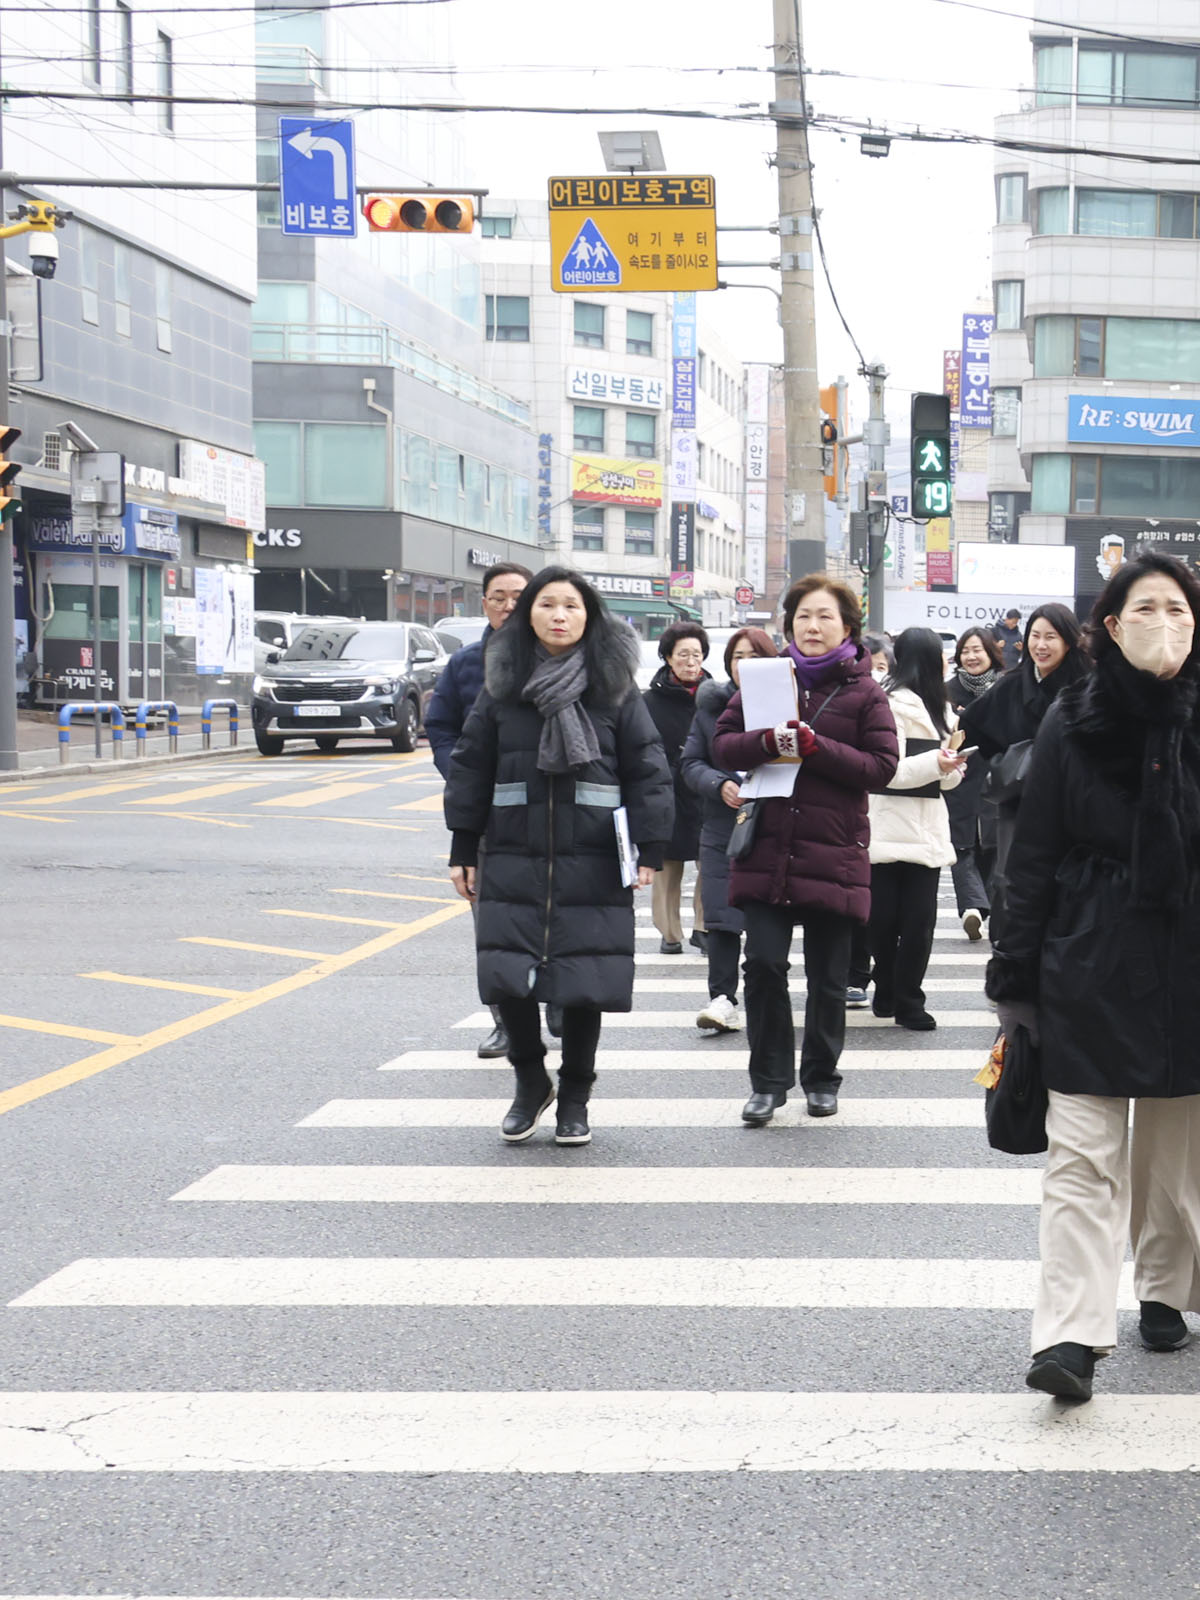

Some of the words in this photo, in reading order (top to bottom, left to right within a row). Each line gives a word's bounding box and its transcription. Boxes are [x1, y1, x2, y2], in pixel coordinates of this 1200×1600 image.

[552, 178, 710, 205] 어린이보호구역
[286, 202, 352, 231] 비보호
[629, 254, 662, 270] 속도를
[665, 253, 709, 270] 줄이시오
[564, 271, 617, 284] 어린이보호
[572, 370, 663, 405] 선일부동산
[965, 336, 992, 412] 부동산
[924, 481, 948, 512] 19
[253, 528, 301, 547] CKS
[926, 605, 1006, 620] FOLLOW
